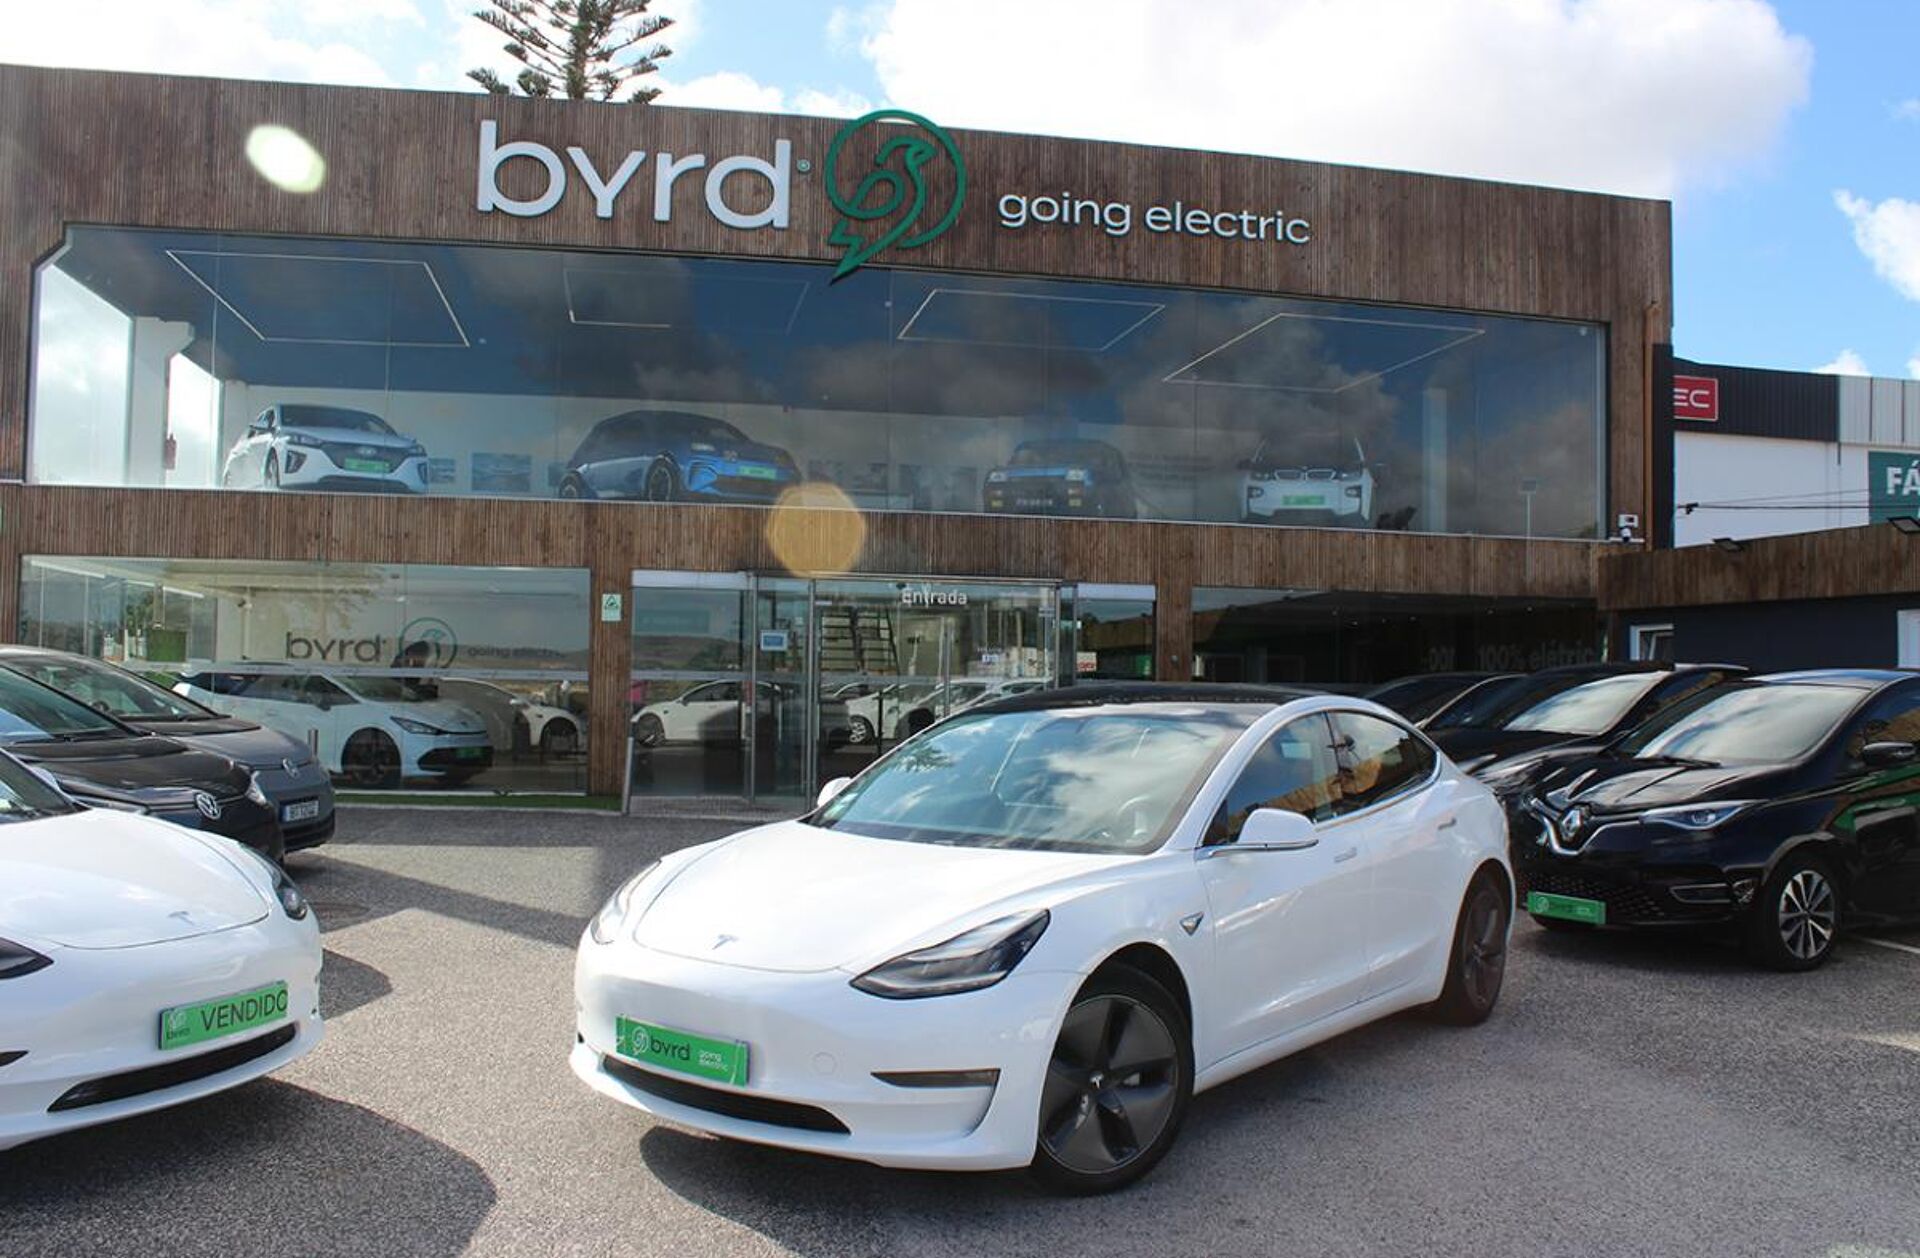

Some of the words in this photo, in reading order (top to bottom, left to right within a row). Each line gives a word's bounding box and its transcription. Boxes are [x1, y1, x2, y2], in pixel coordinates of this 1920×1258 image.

[477, 119, 792, 229] byrd
[999, 192, 1131, 236] going
[1145, 201, 1310, 244] electric
[901, 584, 968, 606] Entrada
[285, 631, 380, 662] byrd
[1477, 643, 1526, 670] 100%
[201, 989, 289, 1031] VENDIDO
[650, 1034, 692, 1061] byrd
